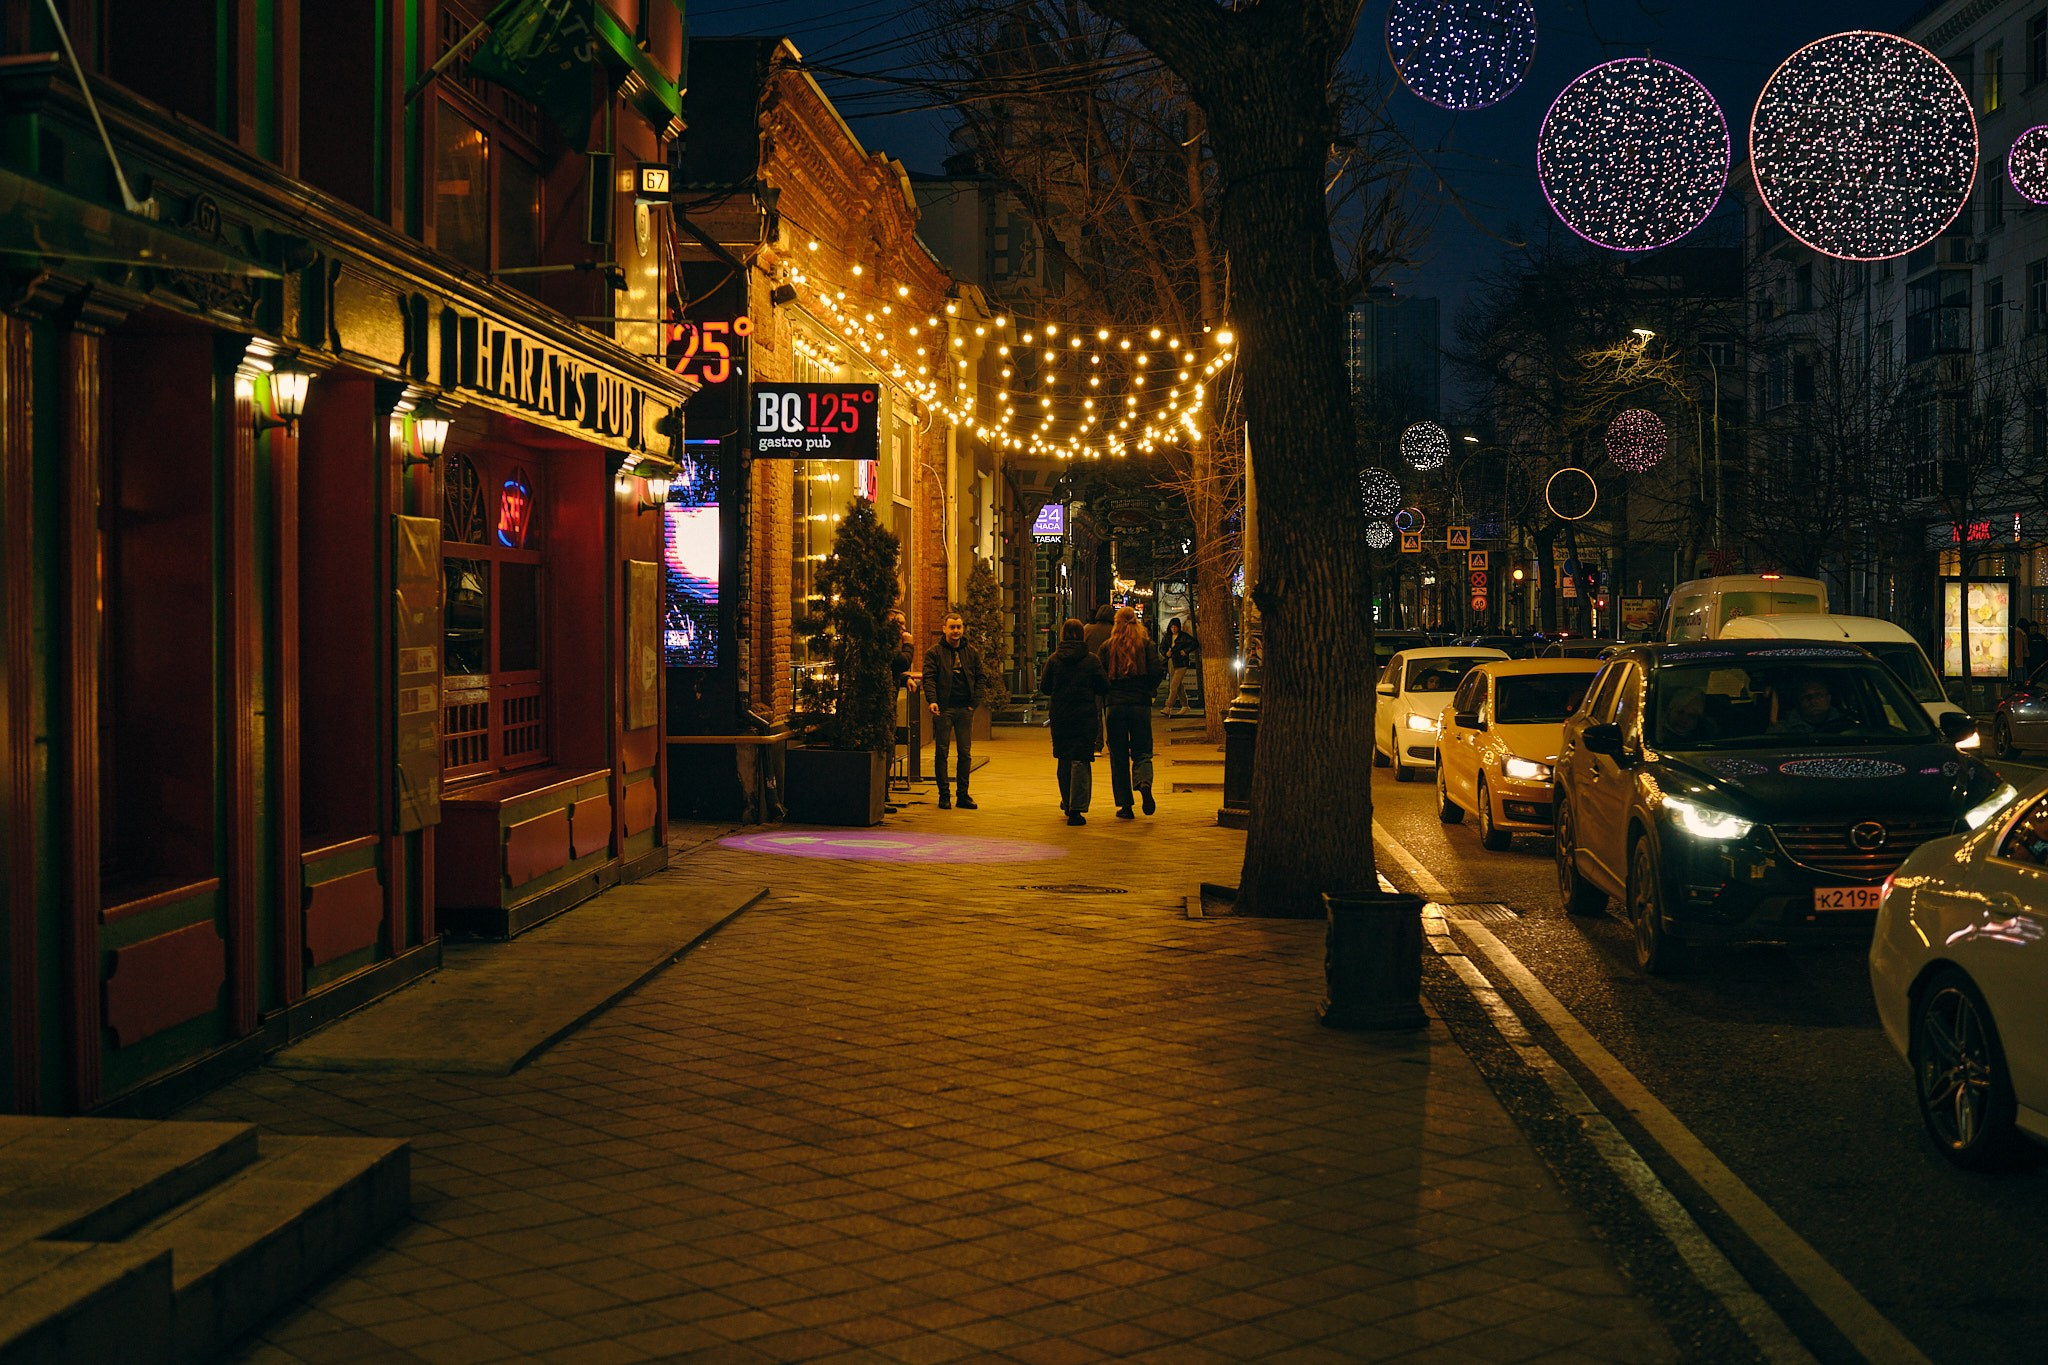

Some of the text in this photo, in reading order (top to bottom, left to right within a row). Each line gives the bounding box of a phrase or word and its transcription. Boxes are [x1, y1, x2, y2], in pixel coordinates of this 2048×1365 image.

[646, 171, 665, 190] 67
[475, 317, 633, 439] HARAT'S PUB
[758, 434, 832, 451] gastro pub
[1036, 508, 1061, 523] 24
[1035, 522, 1061, 530] ЧАСА
[1034, 535, 1062, 543] ТАБАК
